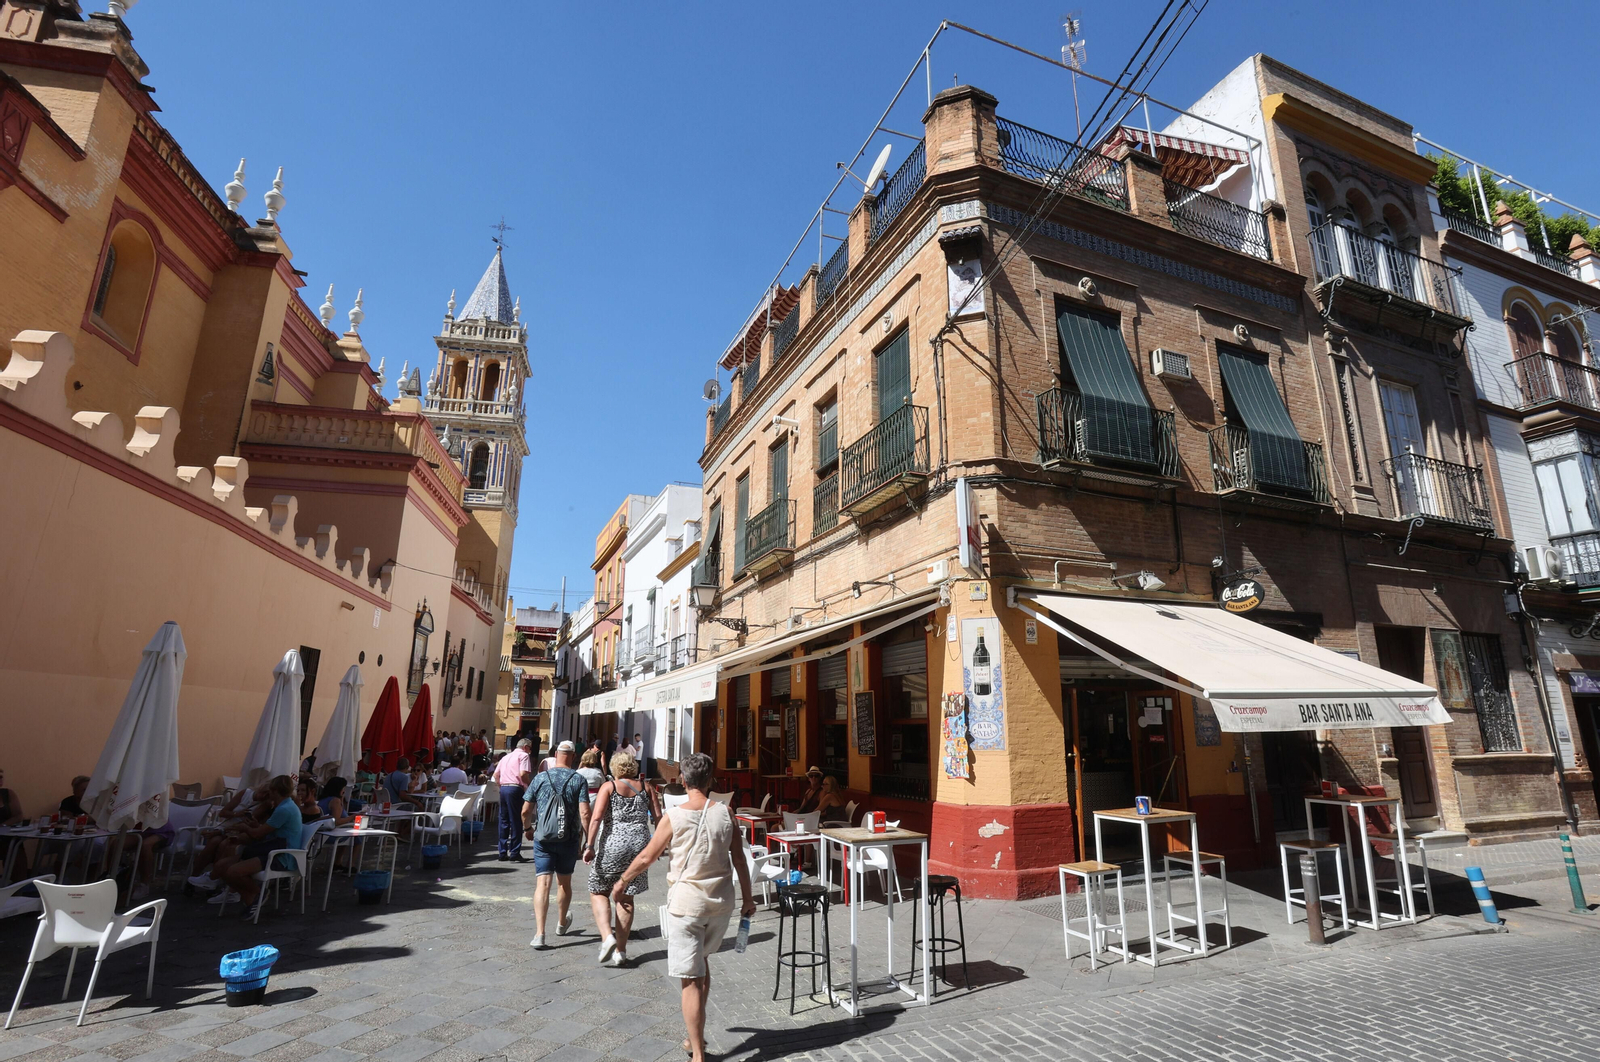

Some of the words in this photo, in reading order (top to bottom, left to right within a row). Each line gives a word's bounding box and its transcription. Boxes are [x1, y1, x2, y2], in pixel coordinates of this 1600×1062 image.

[1229, 705, 1267, 715] Cruzcampo
[1298, 704, 1321, 723] BAR
[1320, 703, 1354, 722] SANTA
[1353, 702, 1375, 721] ANA
[1398, 703, 1429, 712] Cruzcampo
